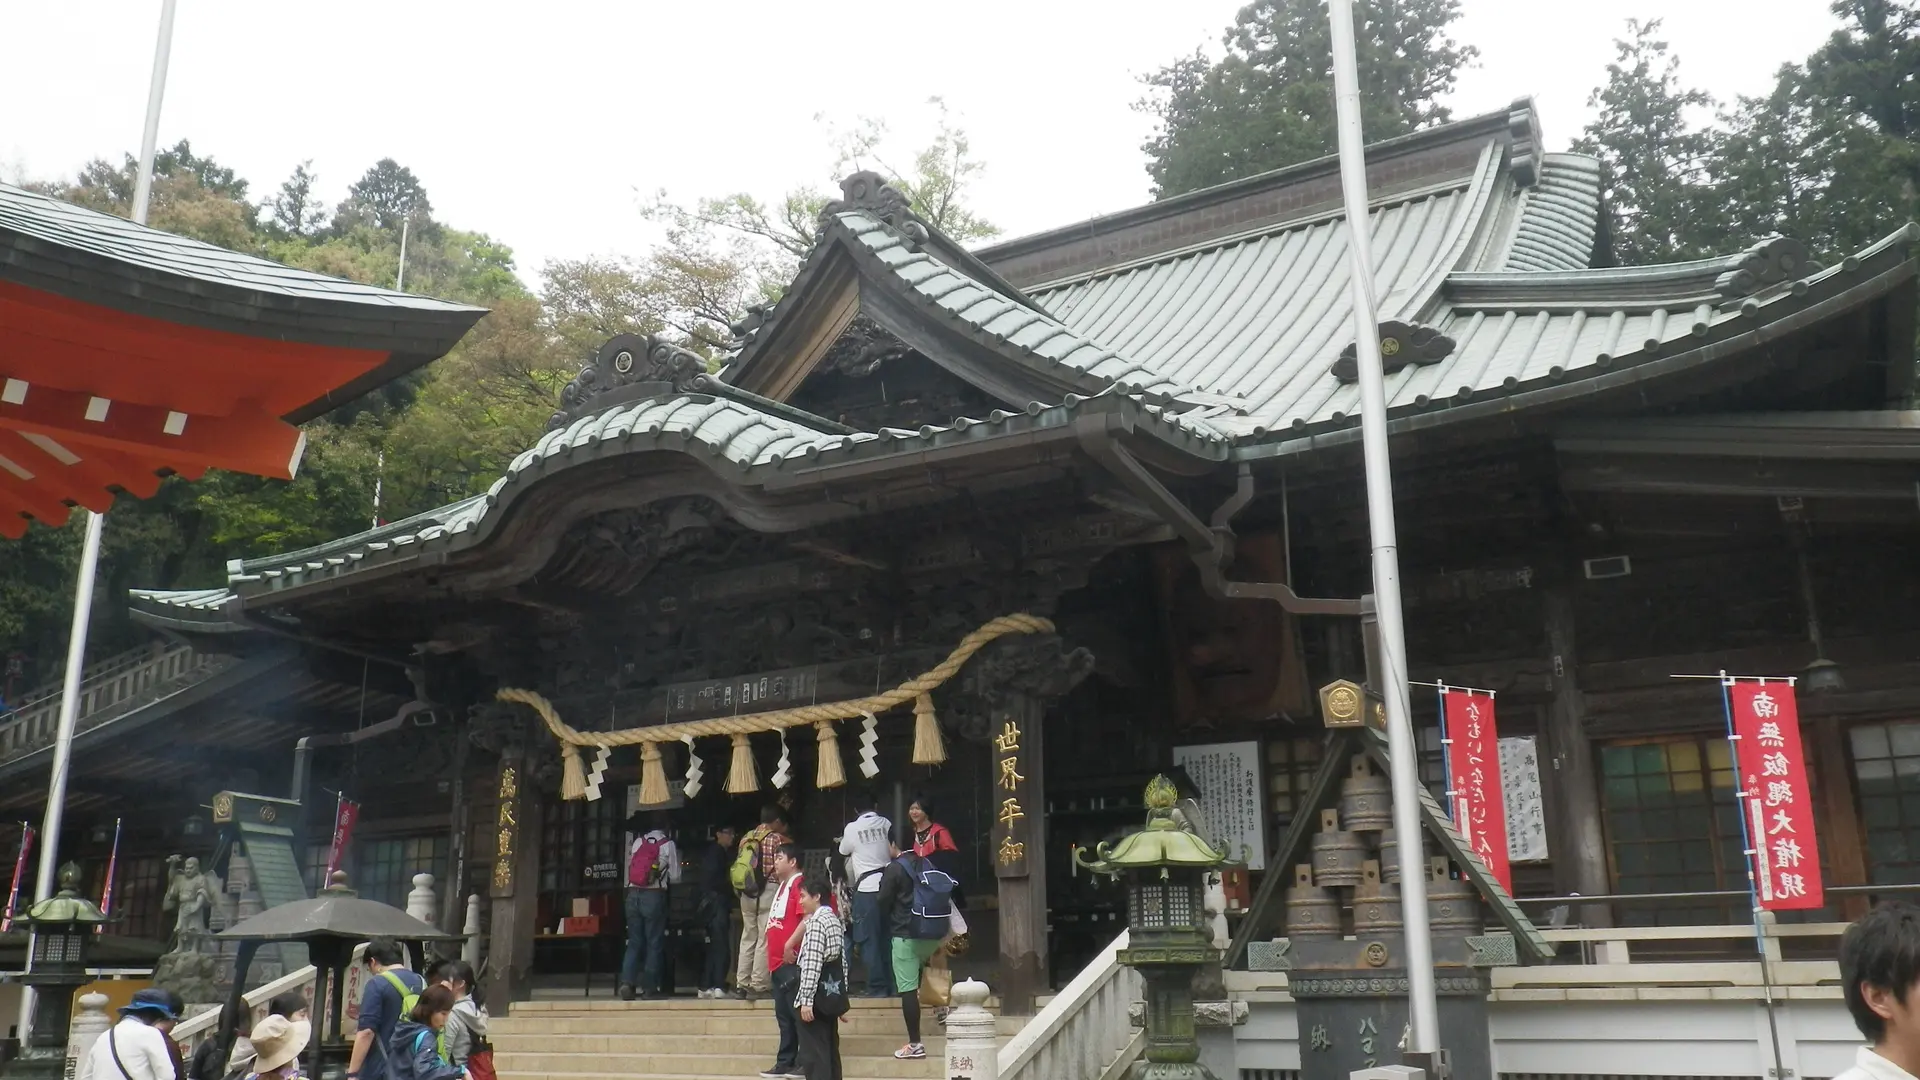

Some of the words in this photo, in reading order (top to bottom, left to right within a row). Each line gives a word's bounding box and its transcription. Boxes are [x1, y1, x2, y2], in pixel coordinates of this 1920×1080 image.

[995, 720, 1025, 867] 世界平和
[949, 1056, 973, 1071] 奉納
